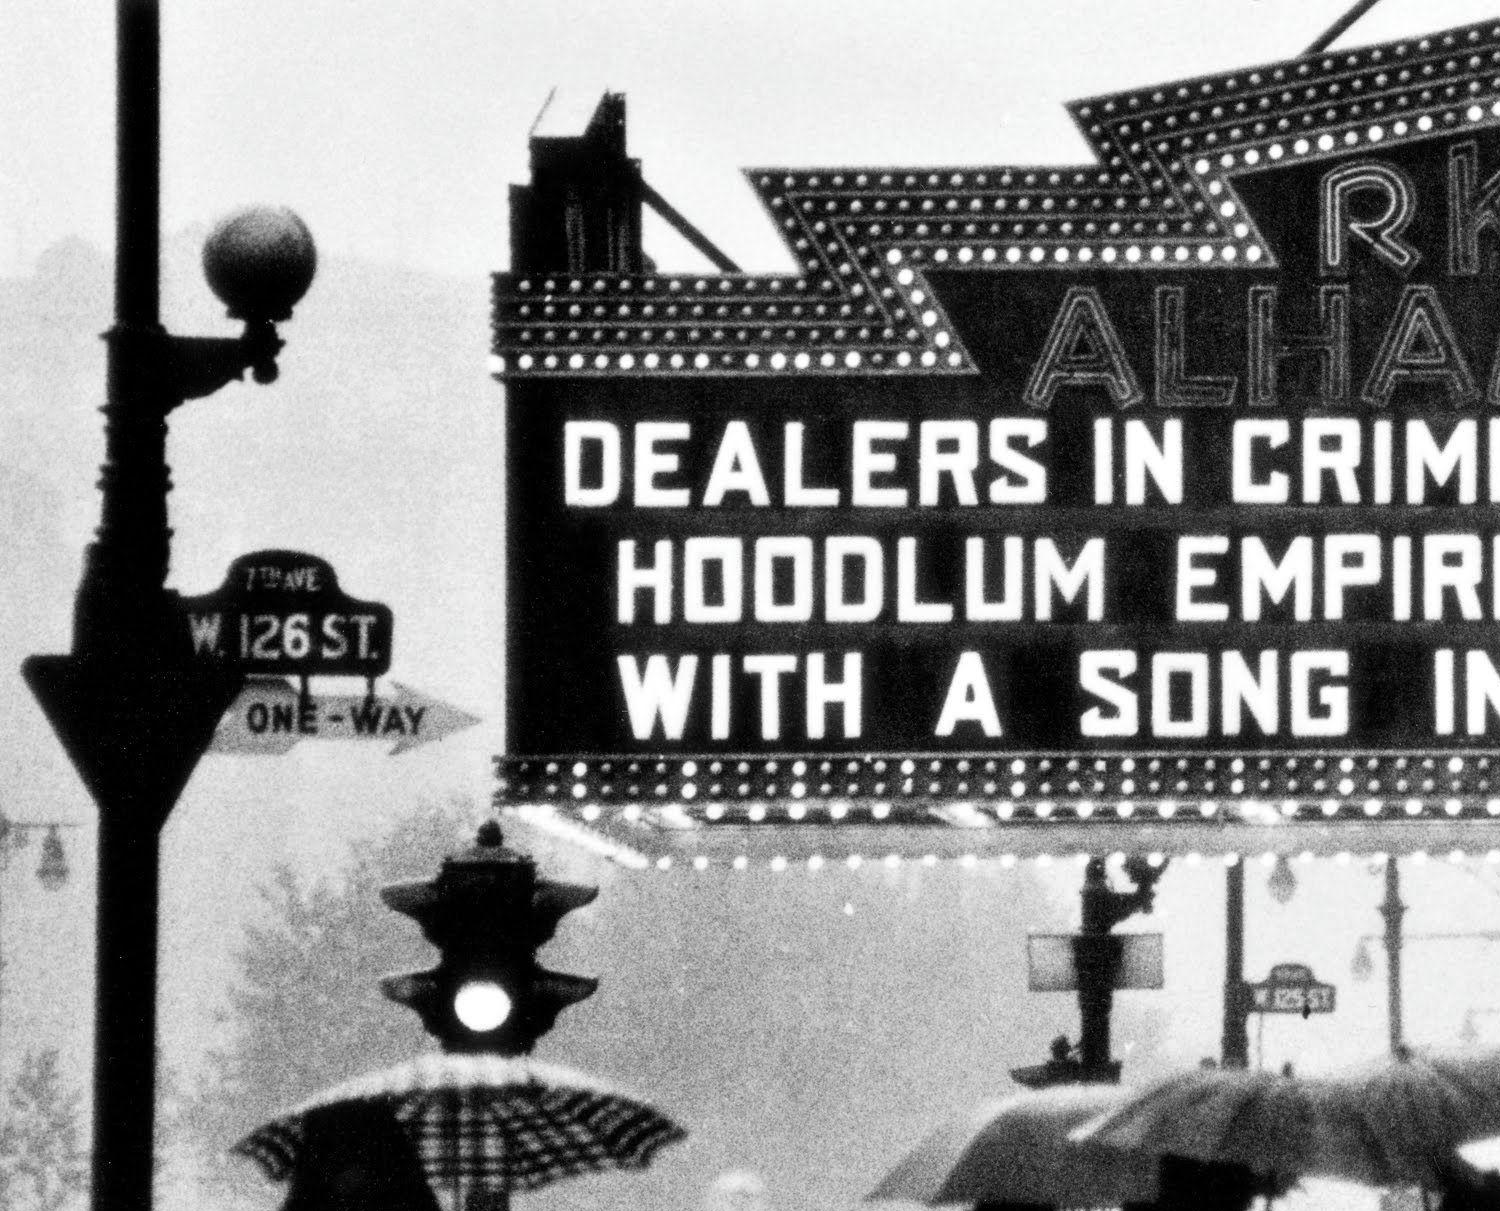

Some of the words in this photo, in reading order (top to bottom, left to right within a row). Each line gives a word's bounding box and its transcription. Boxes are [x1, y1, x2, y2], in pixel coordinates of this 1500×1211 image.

[564, 418, 1047, 507] DEALERS
[1094, 418, 1183, 505] IN
[618, 535, 1105, 624] HOODLUM
[241, 613, 311, 660] 126
[617, 652, 862, 740] WITH
[935, 651, 1002, 737] A
[1079, 649, 1349, 737] SONG
